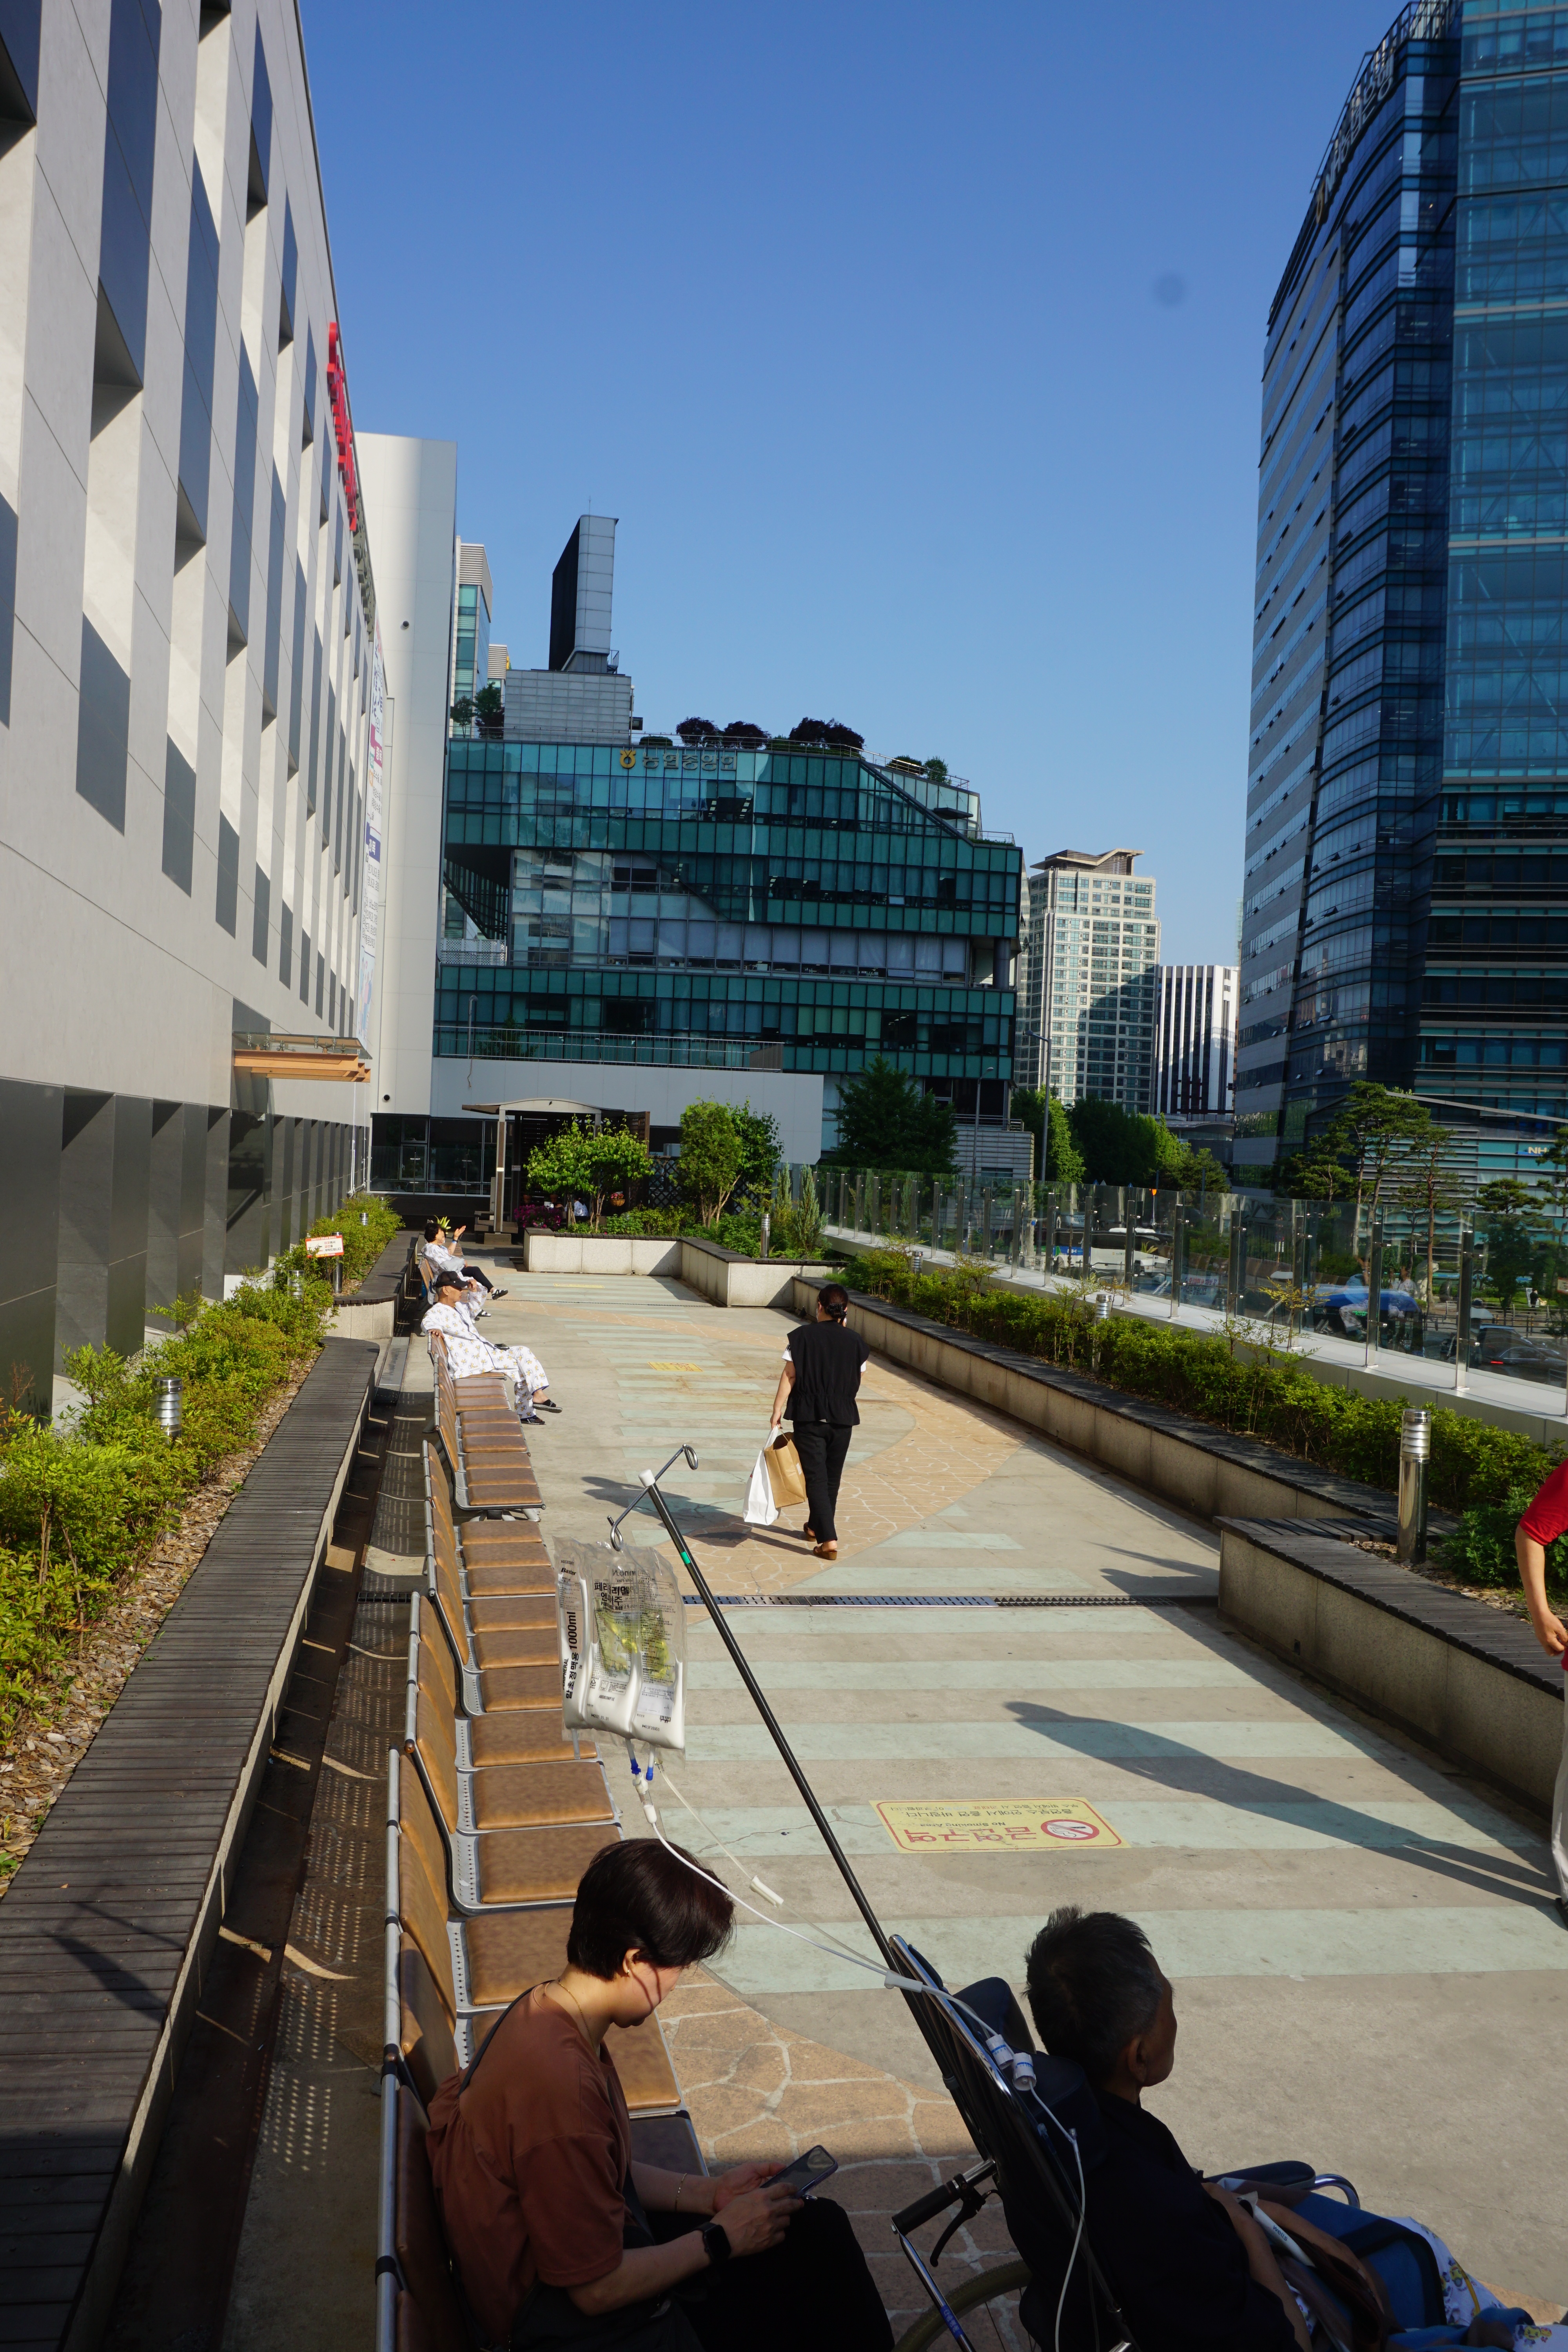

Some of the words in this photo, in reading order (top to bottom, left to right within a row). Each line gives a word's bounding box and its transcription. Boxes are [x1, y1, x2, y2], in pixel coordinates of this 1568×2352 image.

[642, 751, 737, 771] 농협중앙회
[566, 1612, 577, 1650] 1000ml
[566, 1652, 579, 1699] 말초정맥용
[904, 1827, 1036, 1843] 금연구역
[1273, 2225, 1288, 2241] wells
